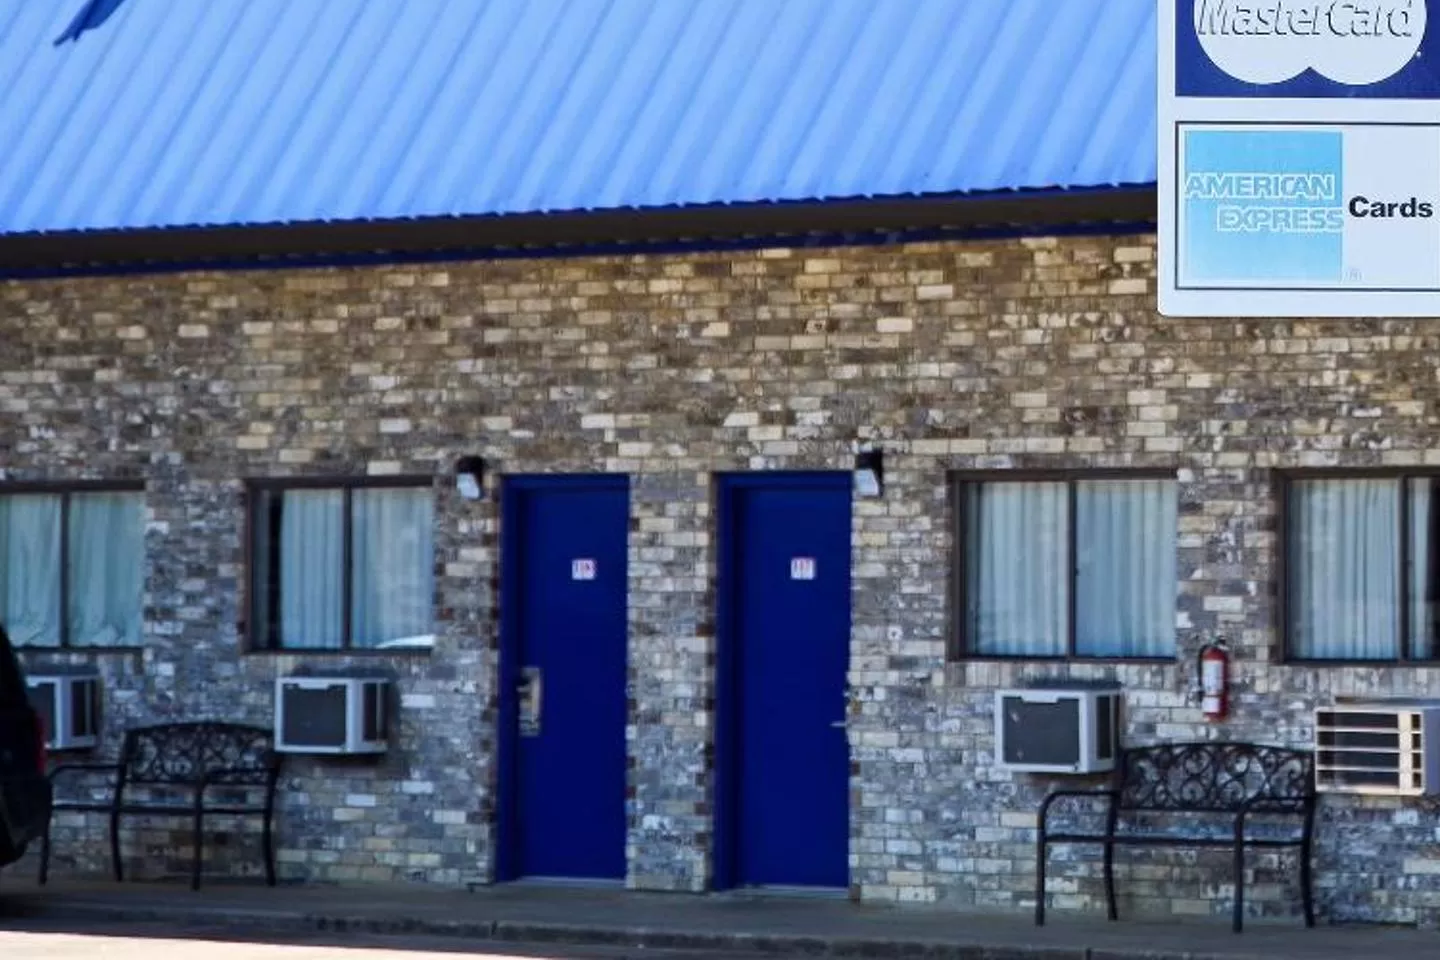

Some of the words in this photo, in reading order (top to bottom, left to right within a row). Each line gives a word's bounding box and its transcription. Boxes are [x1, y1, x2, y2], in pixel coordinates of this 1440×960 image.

[1184, 172, 1336, 200] AMERICAN
[1217, 206, 1344, 233] EXPRESS
[1348, 195, 1434, 218] Cards
